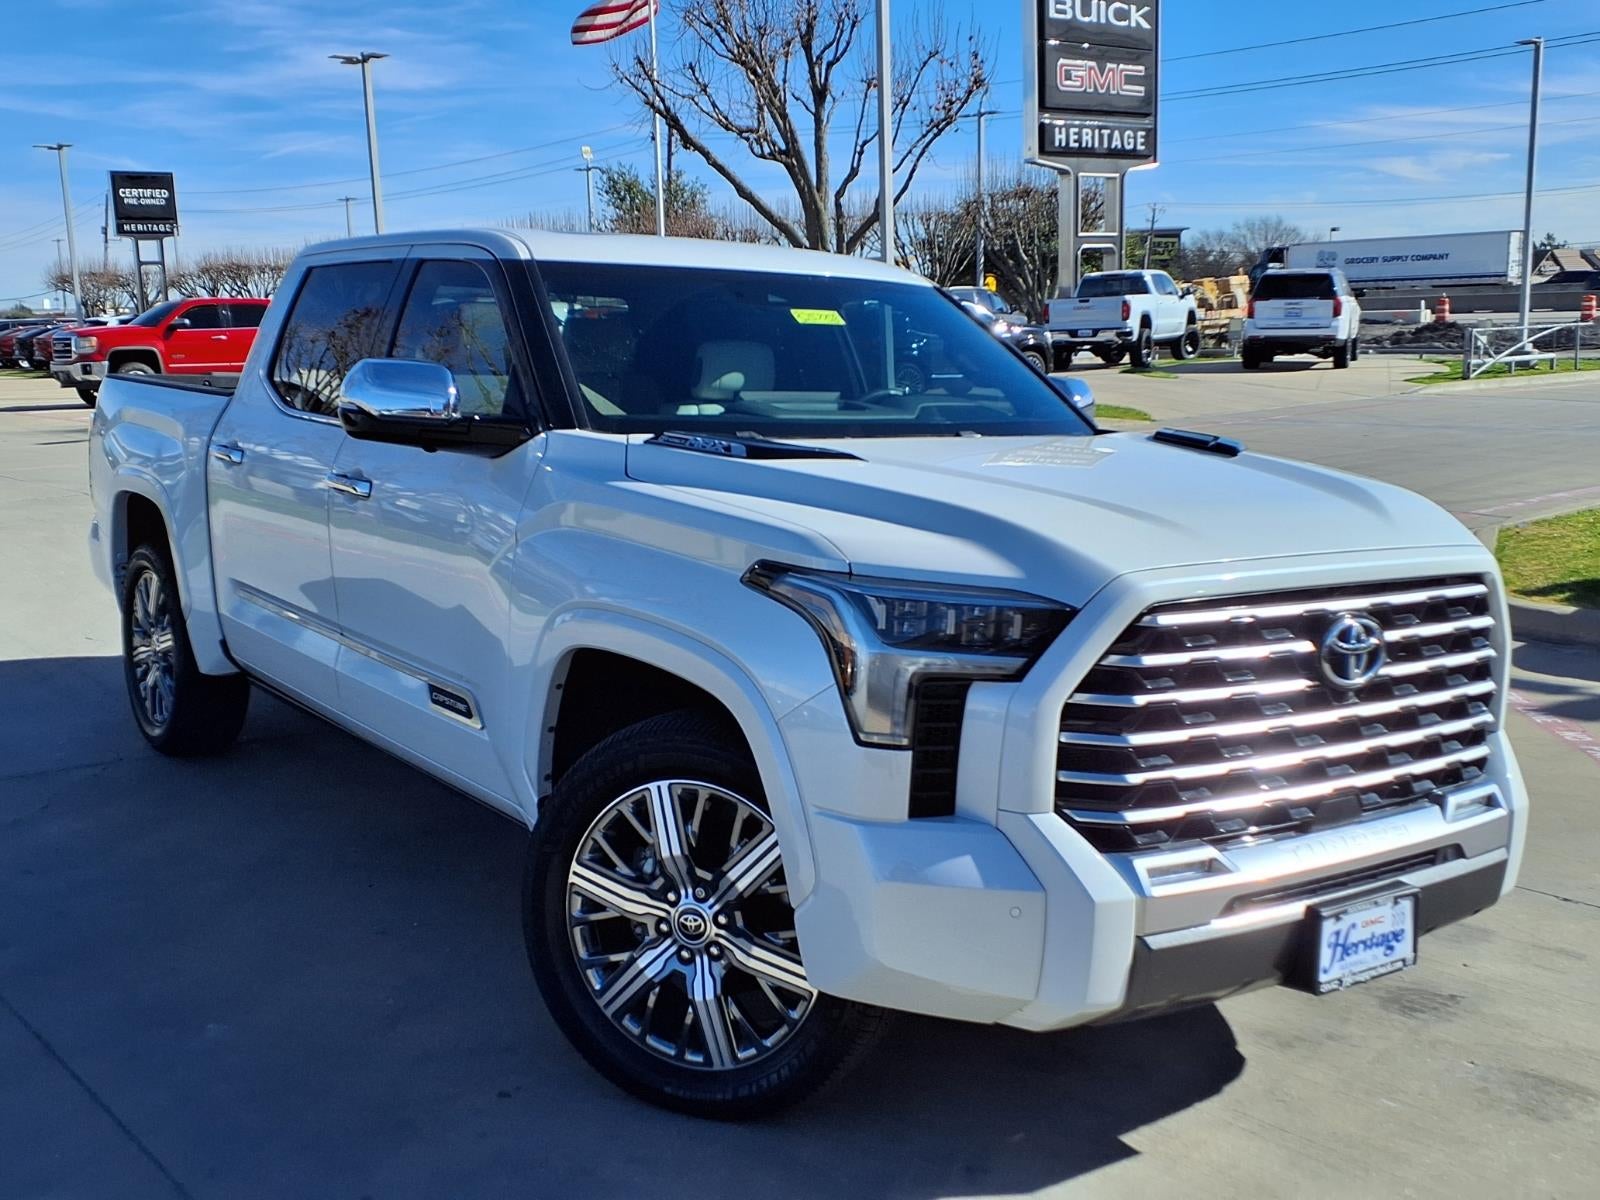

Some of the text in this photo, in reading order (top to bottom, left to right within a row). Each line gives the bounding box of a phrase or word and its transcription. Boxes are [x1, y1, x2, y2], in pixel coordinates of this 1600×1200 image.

[1049, 0, 1151, 29] BUICK
[1057, 57, 1145, 96] GMC
[1054, 127, 1146, 150] HERITAGE
[119, 188, 169, 197] CERTIFIED
[123, 223, 172, 231] HERITAGE
[1344, 256, 1379, 265] GROCERY
[1381, 255, 1410, 263] SUPPLY
[1411, 253, 1449, 261] COMPANY
[1322, 922, 1405, 974] Heritage
